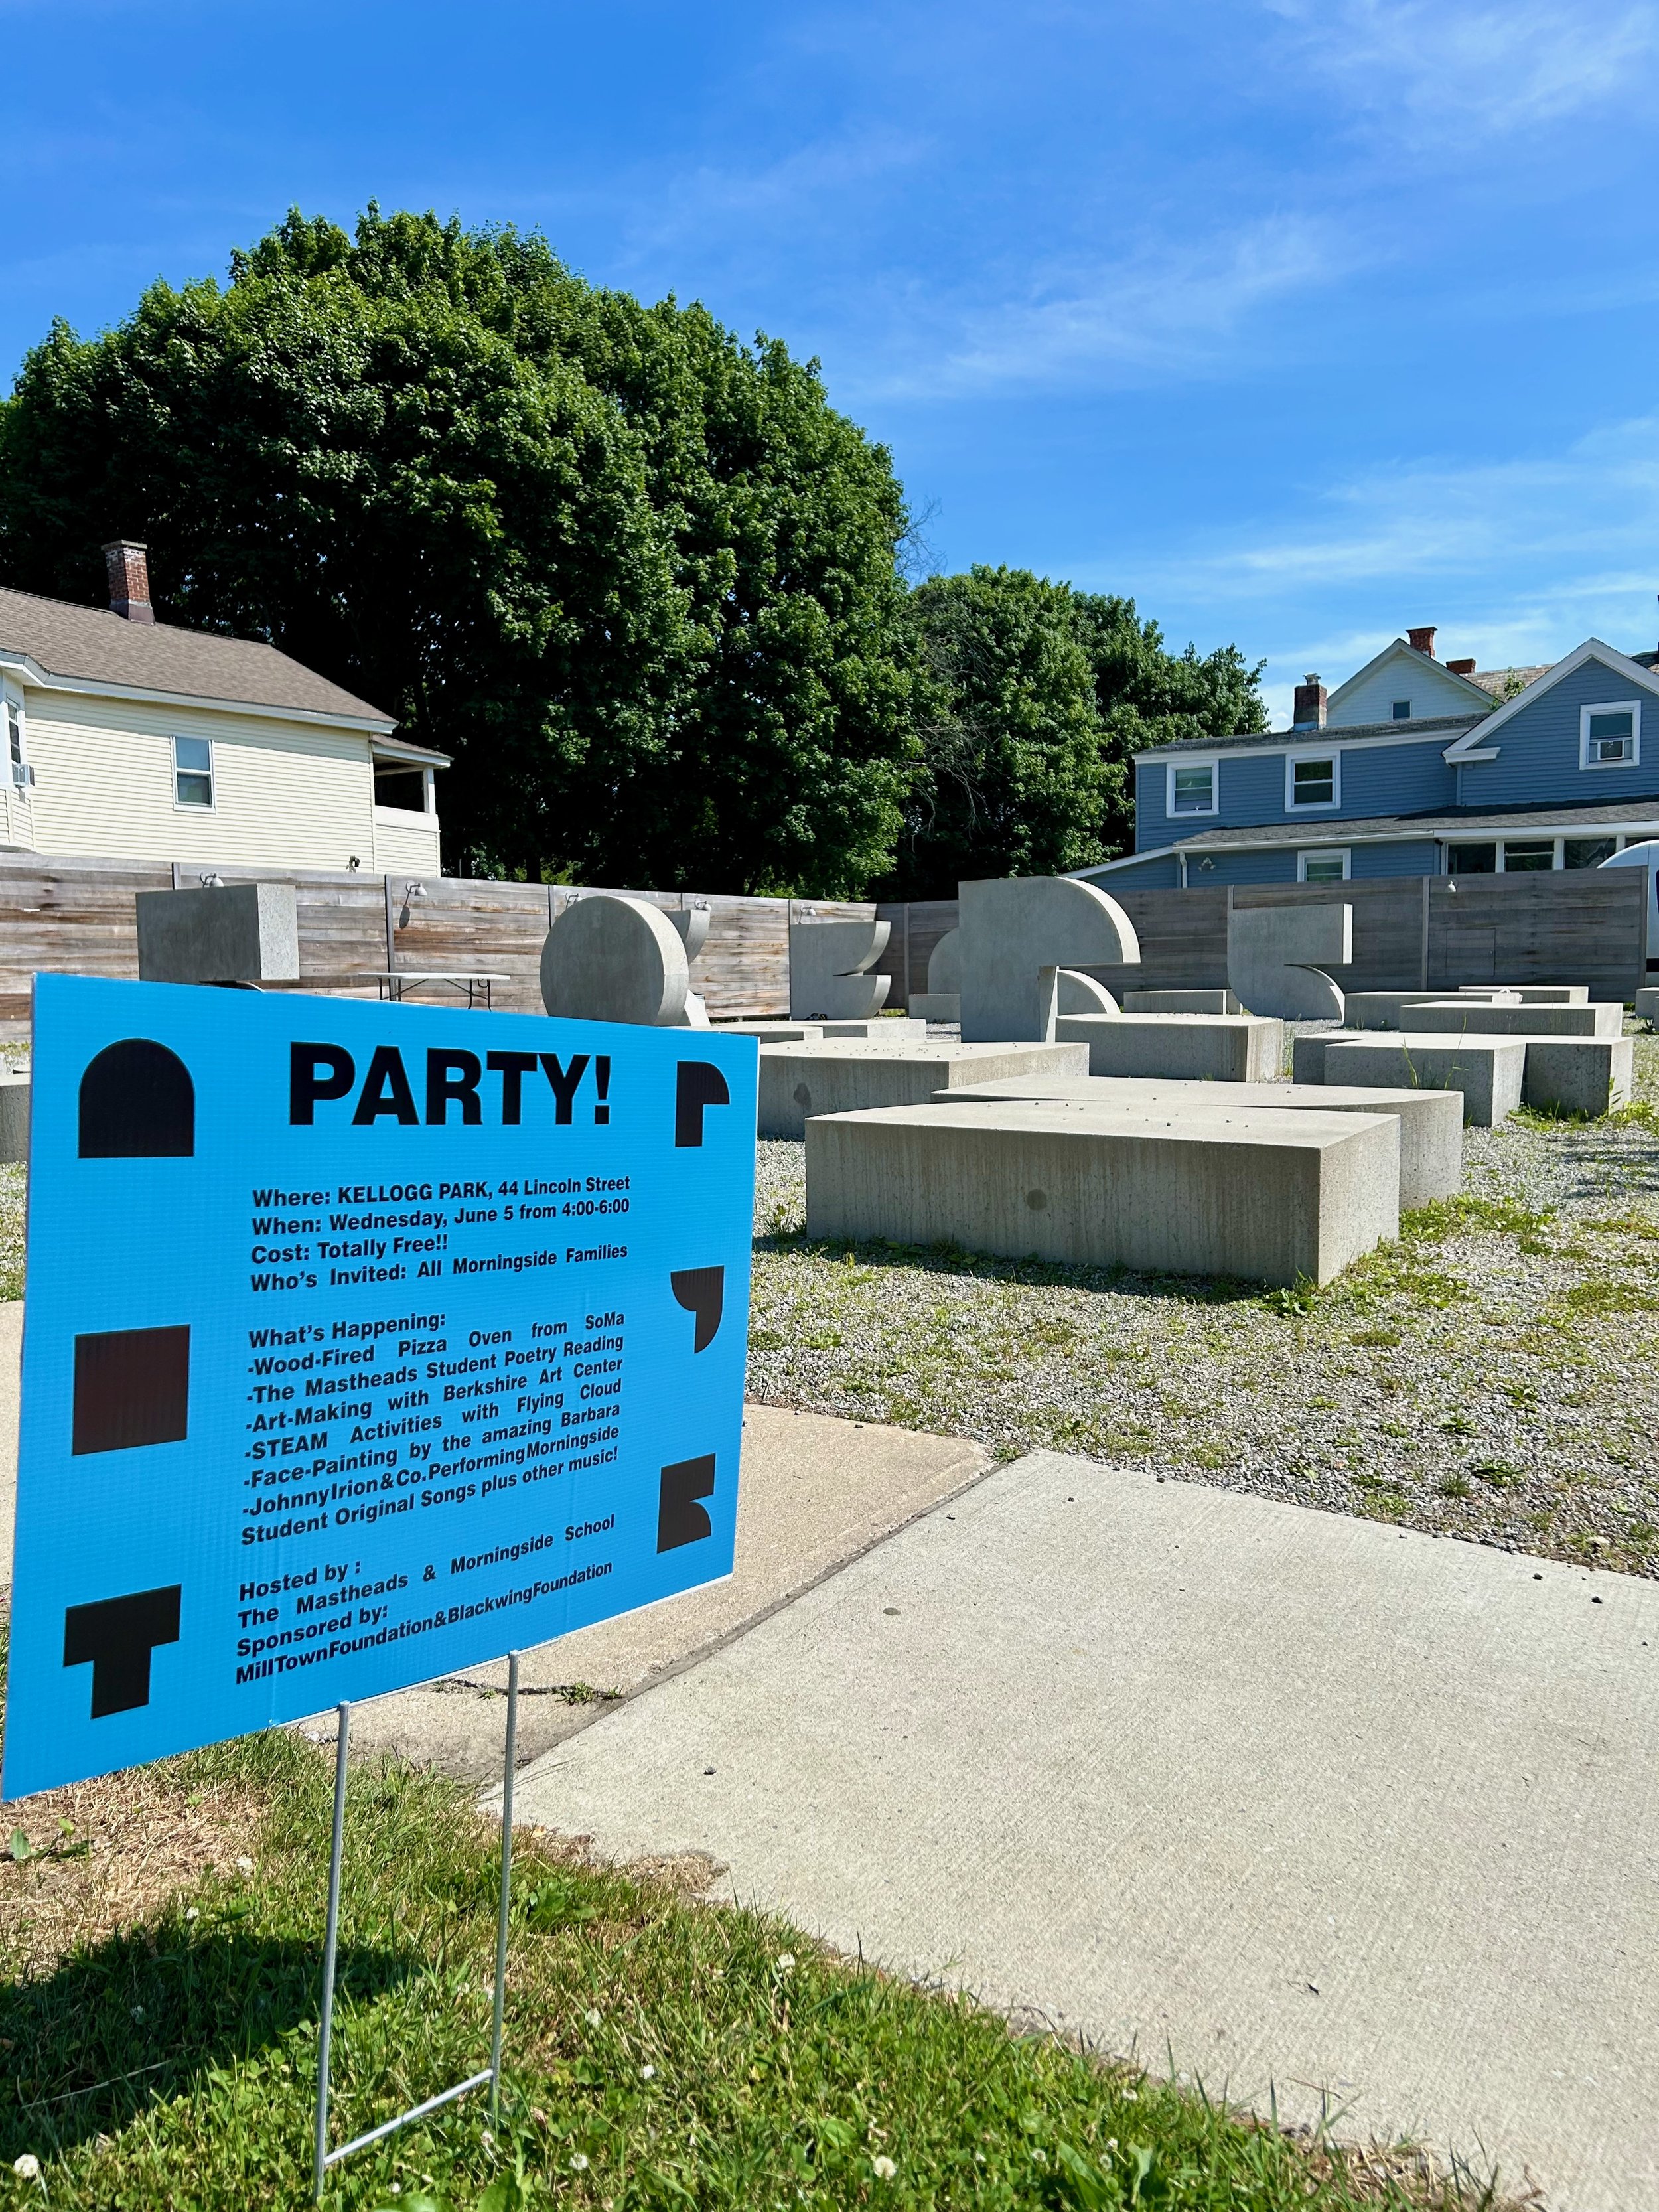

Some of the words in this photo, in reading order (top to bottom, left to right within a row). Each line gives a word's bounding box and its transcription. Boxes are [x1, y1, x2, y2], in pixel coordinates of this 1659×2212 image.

[289, 1041, 611, 1125] PARTY!
[252, 1217, 321, 1235] When:
[330, 1210, 447, 1230] Wednesday,
[455, 1208, 497, 1223] June
[504, 1205, 513, 1220] 5
[520, 1204, 556, 1219] from
[562, 1198, 629, 1216] 4:00-6:00
[253, 1189, 330, 1207] Where:
[338, 1184, 432, 1203] KELLOGG
[439, 1182, 492, 1200] PARK,
[498, 1181, 518, 1195] 44
[524, 1179, 581, 1195] Lincoln
[587, 1176, 630, 1191] Street
[251, 1272, 317, 1291] Who's
[331, 1264, 405, 1285] Invited:
[417, 1260, 441, 1277] All
[453, 1250, 557, 1274] Morningside
[567, 1244, 627, 1262] Families
[252, 1244, 309, 1264] Cost:
[317, 1239, 386, 1259] Totally
[394, 1234, 447, 1253] Free!!
[250, 1325, 324, 1348] What's
[332, 1313, 445, 1340] Happening:
[399, 1339, 446, 1357] Pizza
[469, 1331, 511, 1347] Oven
[532, 1323, 567, 1338] from
[586, 1312, 624, 1329] SoMa
[306, 1366, 417, 1396] Mastheads
[427, 1354, 496, 1378] Student
[505, 1347, 556, 1366] Poetry
[564, 1336, 623, 1357] Reading
[388, 1390, 428, 1410] with
[444, 1375, 527, 1401] Berkshire
[539, 1367, 562, 1384] Art
[574, 1359, 622, 1378] Center
[350, 1416, 441, 1443] Activities
[462, 1403, 498, 1422] with
[518, 1393, 563, 1414] Flying
[581, 1378, 621, 1399] Cloud
[410, 1443, 431, 1460] by
[443, 1435, 470, 1451] the
[482, 1420, 551, 1443] amazing
[561, 1405, 619, 1427] Barbara
[242, 1512, 328, 1545] Student
[336, 1494, 414, 1525] Original
[421, 1484, 475, 1507] Songs
[482, 1475, 516, 1497] plus
[523, 1463, 563, 1483] other
[569, 1446, 617, 1471] music!
[238, 1608, 279, 1628] The
[297, 1574, 407, 1614] Mastheads
[423, 1565, 435, 1582] &
[451, 1534, 553, 1574] Morningside
[565, 1514, 614, 1541] School
[240, 1568, 317, 1601] Hosted
[238, 1611, 352, 1658] Sponsored
[360, 1606, 387, 1625] by:
